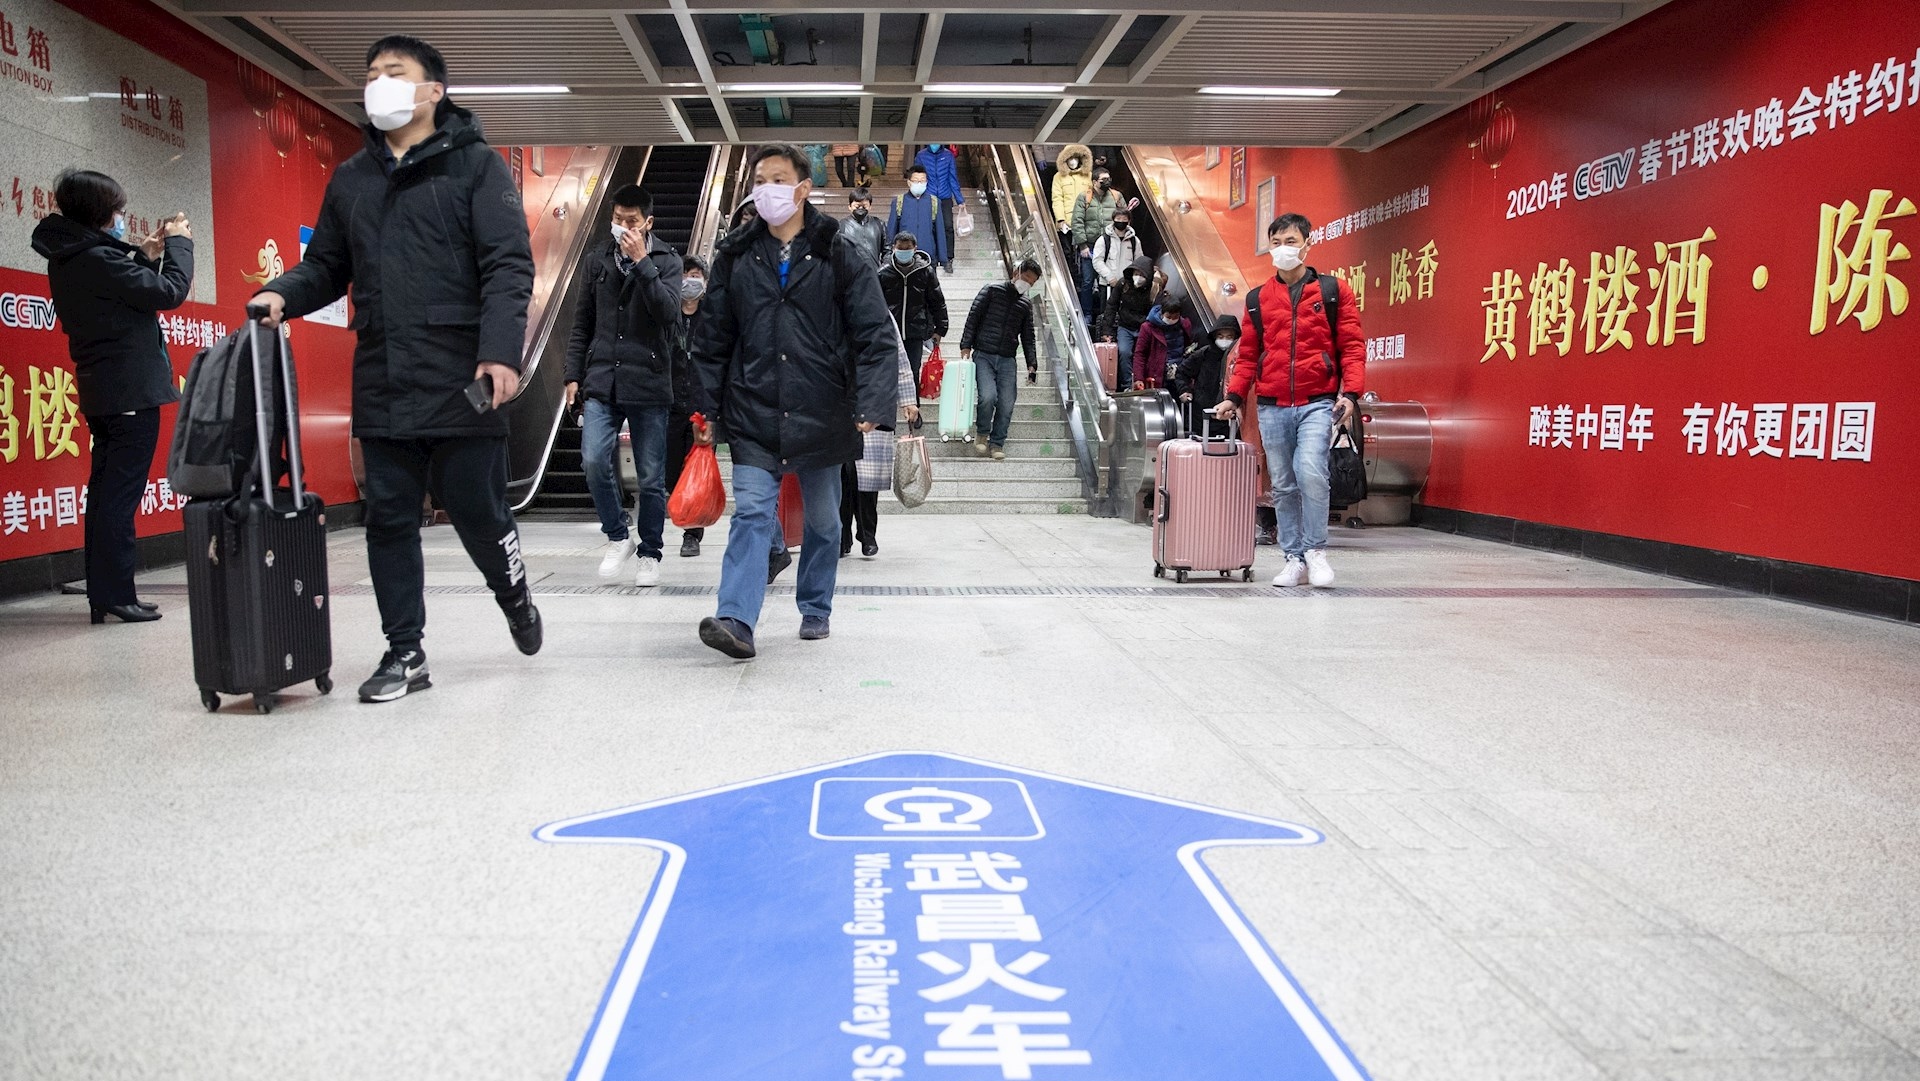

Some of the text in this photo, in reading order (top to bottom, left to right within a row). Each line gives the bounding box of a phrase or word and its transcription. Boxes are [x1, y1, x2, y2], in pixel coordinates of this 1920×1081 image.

[33, 73, 54, 96] BOX
[120, 75, 184, 131] 配电箱
[121, 113, 186, 150] DISTRIBUTION BOX
[1506, 172, 1567, 220] 2020年
[1573, 147, 1636, 201] CCTV
[1309, 226, 1324, 245] 20年
[1345, 185, 1429, 234] 春节联欢晚会特约播出
[0, 292, 57, 331] CCTV
[1366, 334, 1406, 361] 你更团圆
[1528, 402, 1876, 462] 醉美中国年 有你更团圆
[0, 484, 88, 536] 美中国
[839, 852, 907, 1081] Wuchang Railway St
[903, 851, 1093, 1080] 武昌火车
